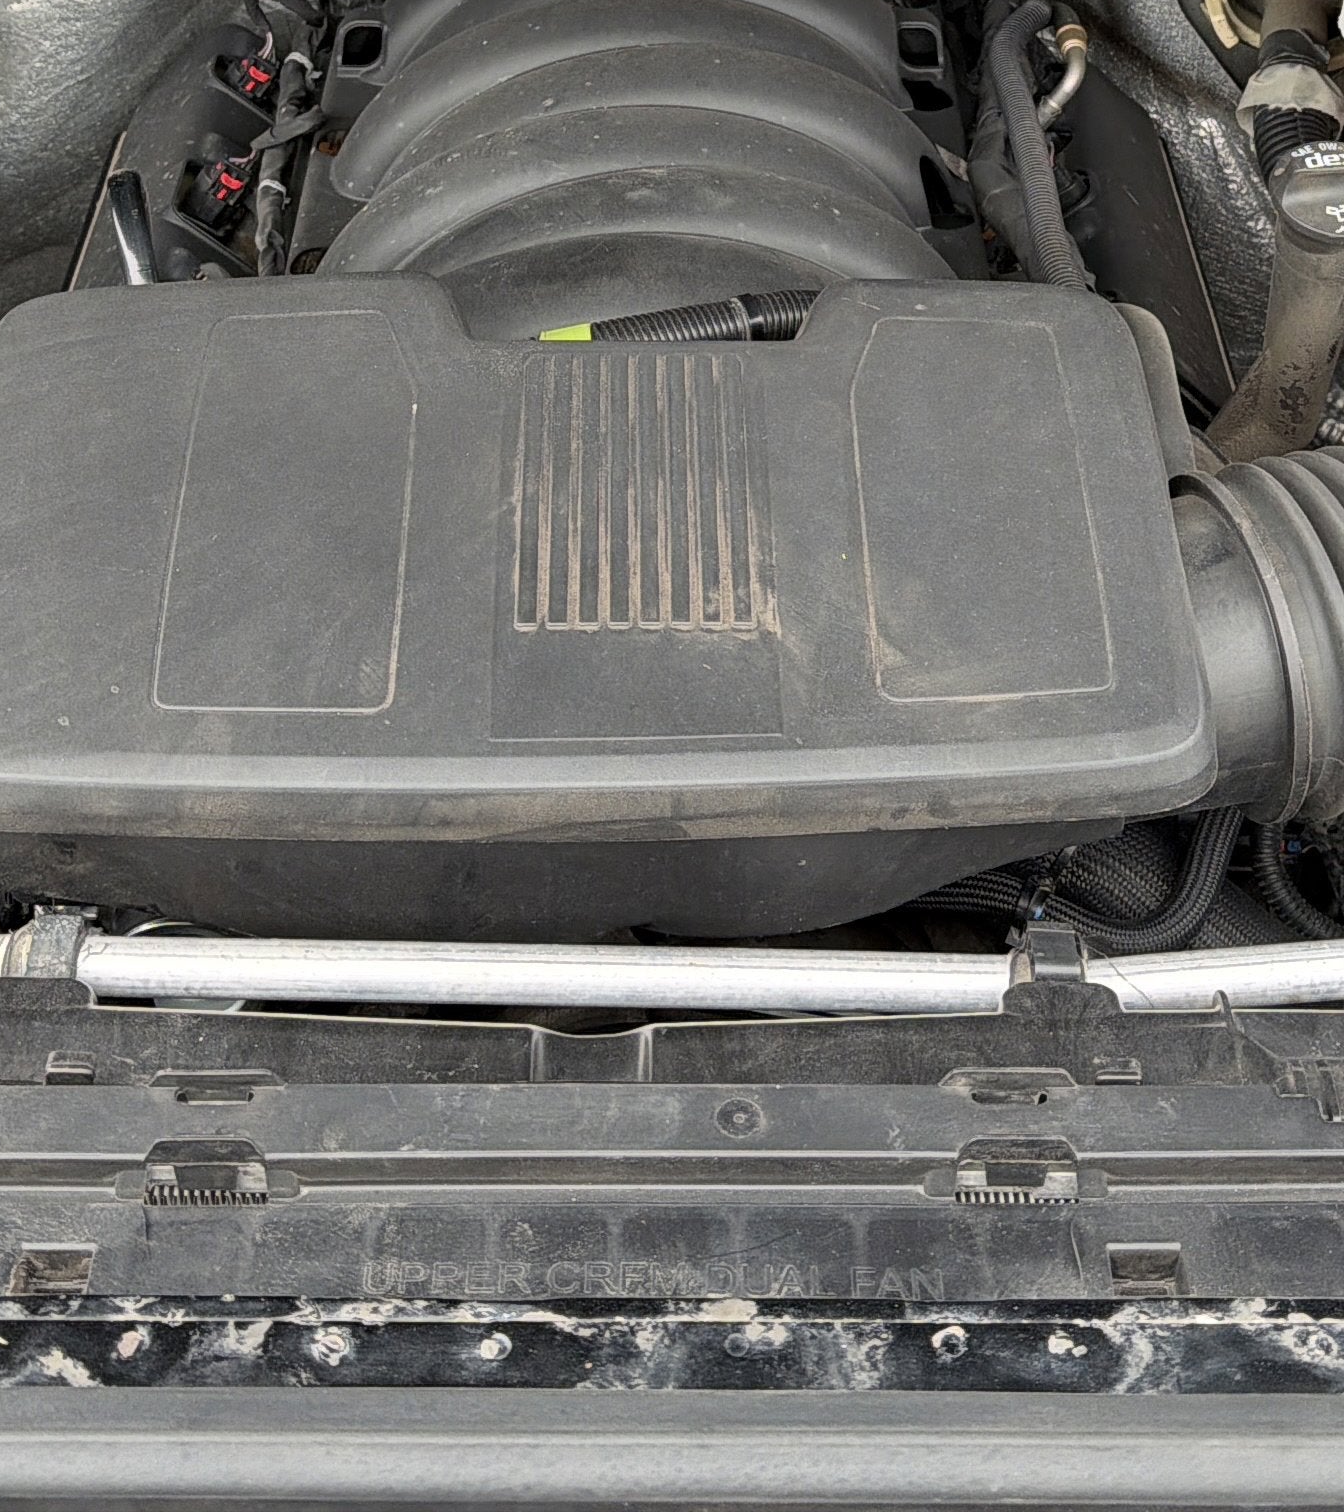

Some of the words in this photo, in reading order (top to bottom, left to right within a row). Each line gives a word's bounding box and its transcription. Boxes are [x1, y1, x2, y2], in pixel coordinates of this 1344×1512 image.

[361, 1260, 532, 1295] UPPER
[706, 1263, 838, 1298] DUAL
[850, 1265, 946, 1301] FAN
